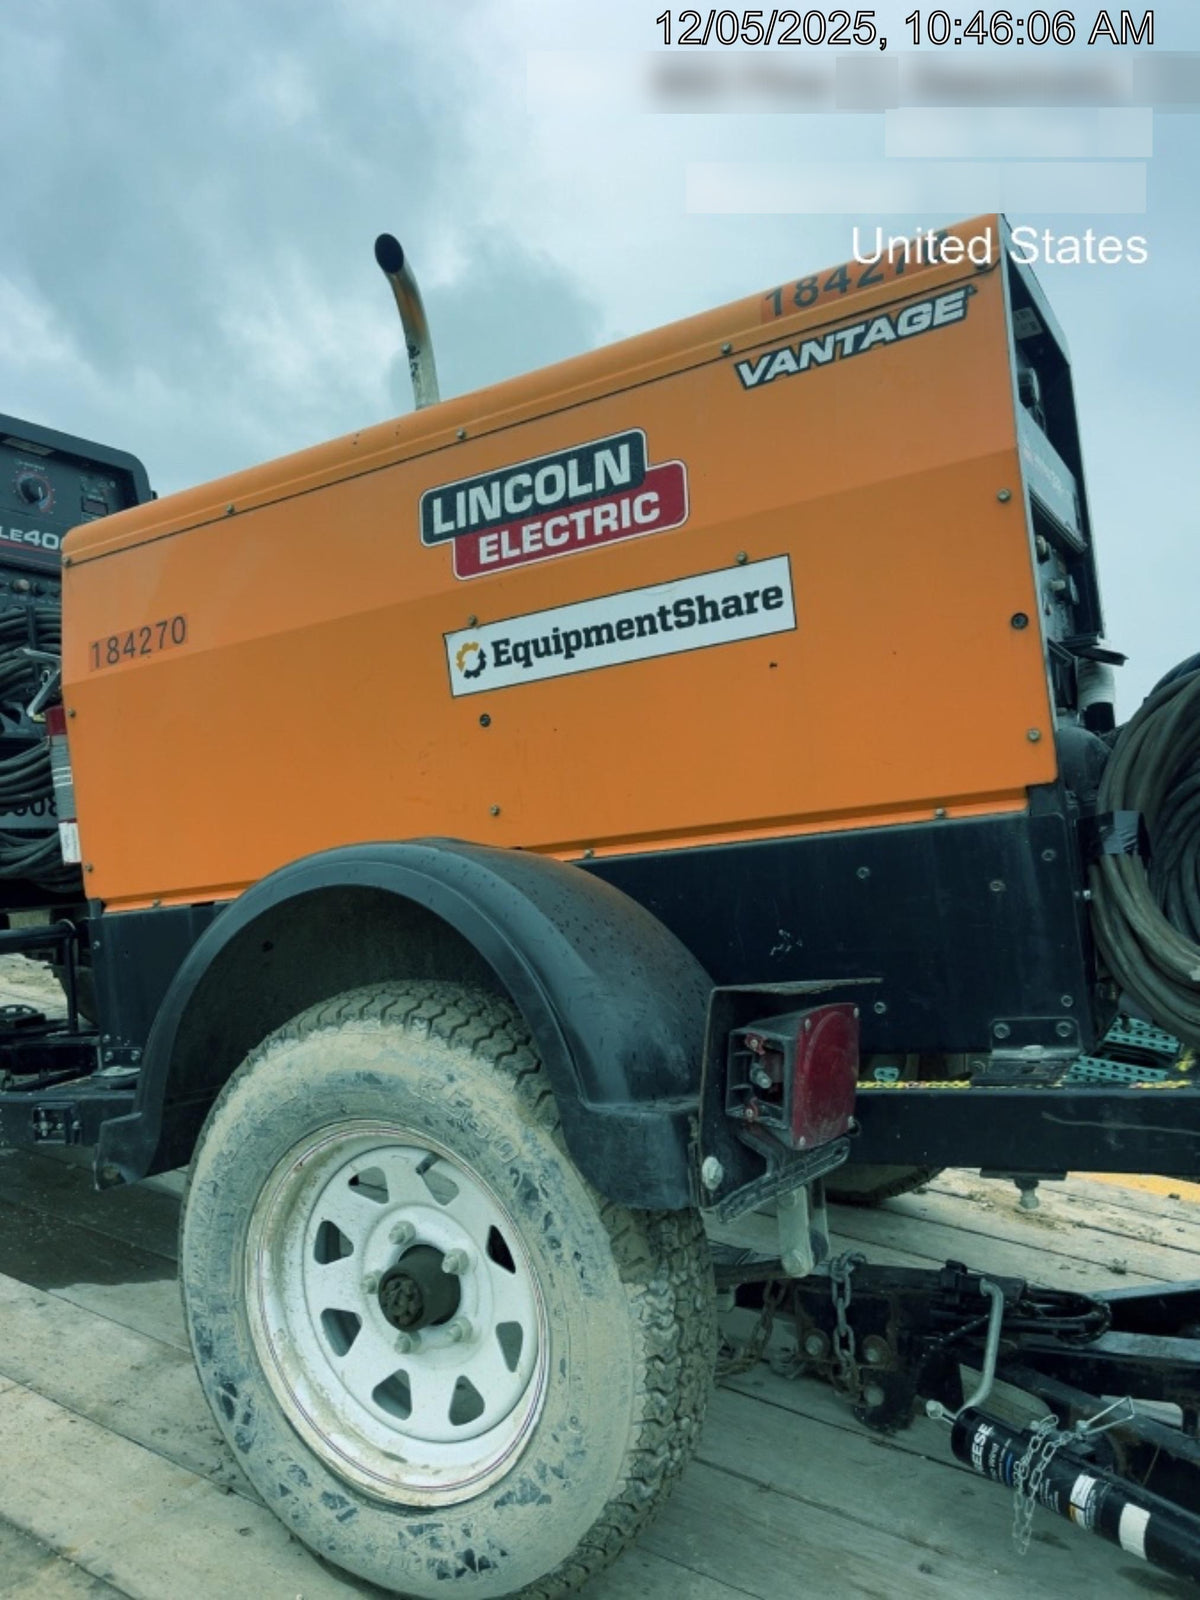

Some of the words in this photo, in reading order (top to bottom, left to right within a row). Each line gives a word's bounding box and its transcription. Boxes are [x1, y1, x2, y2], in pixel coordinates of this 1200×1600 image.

[738, 289, 969, 388] VANTAGE
[432, 443, 631, 535] LINCOLN
[478, 491, 660, 566] ELECTRIC
[0, 525, 63, 551] LE40
[90, 614, 187, 669] 184270
[490, 584, 785, 669] EquipmentShare
